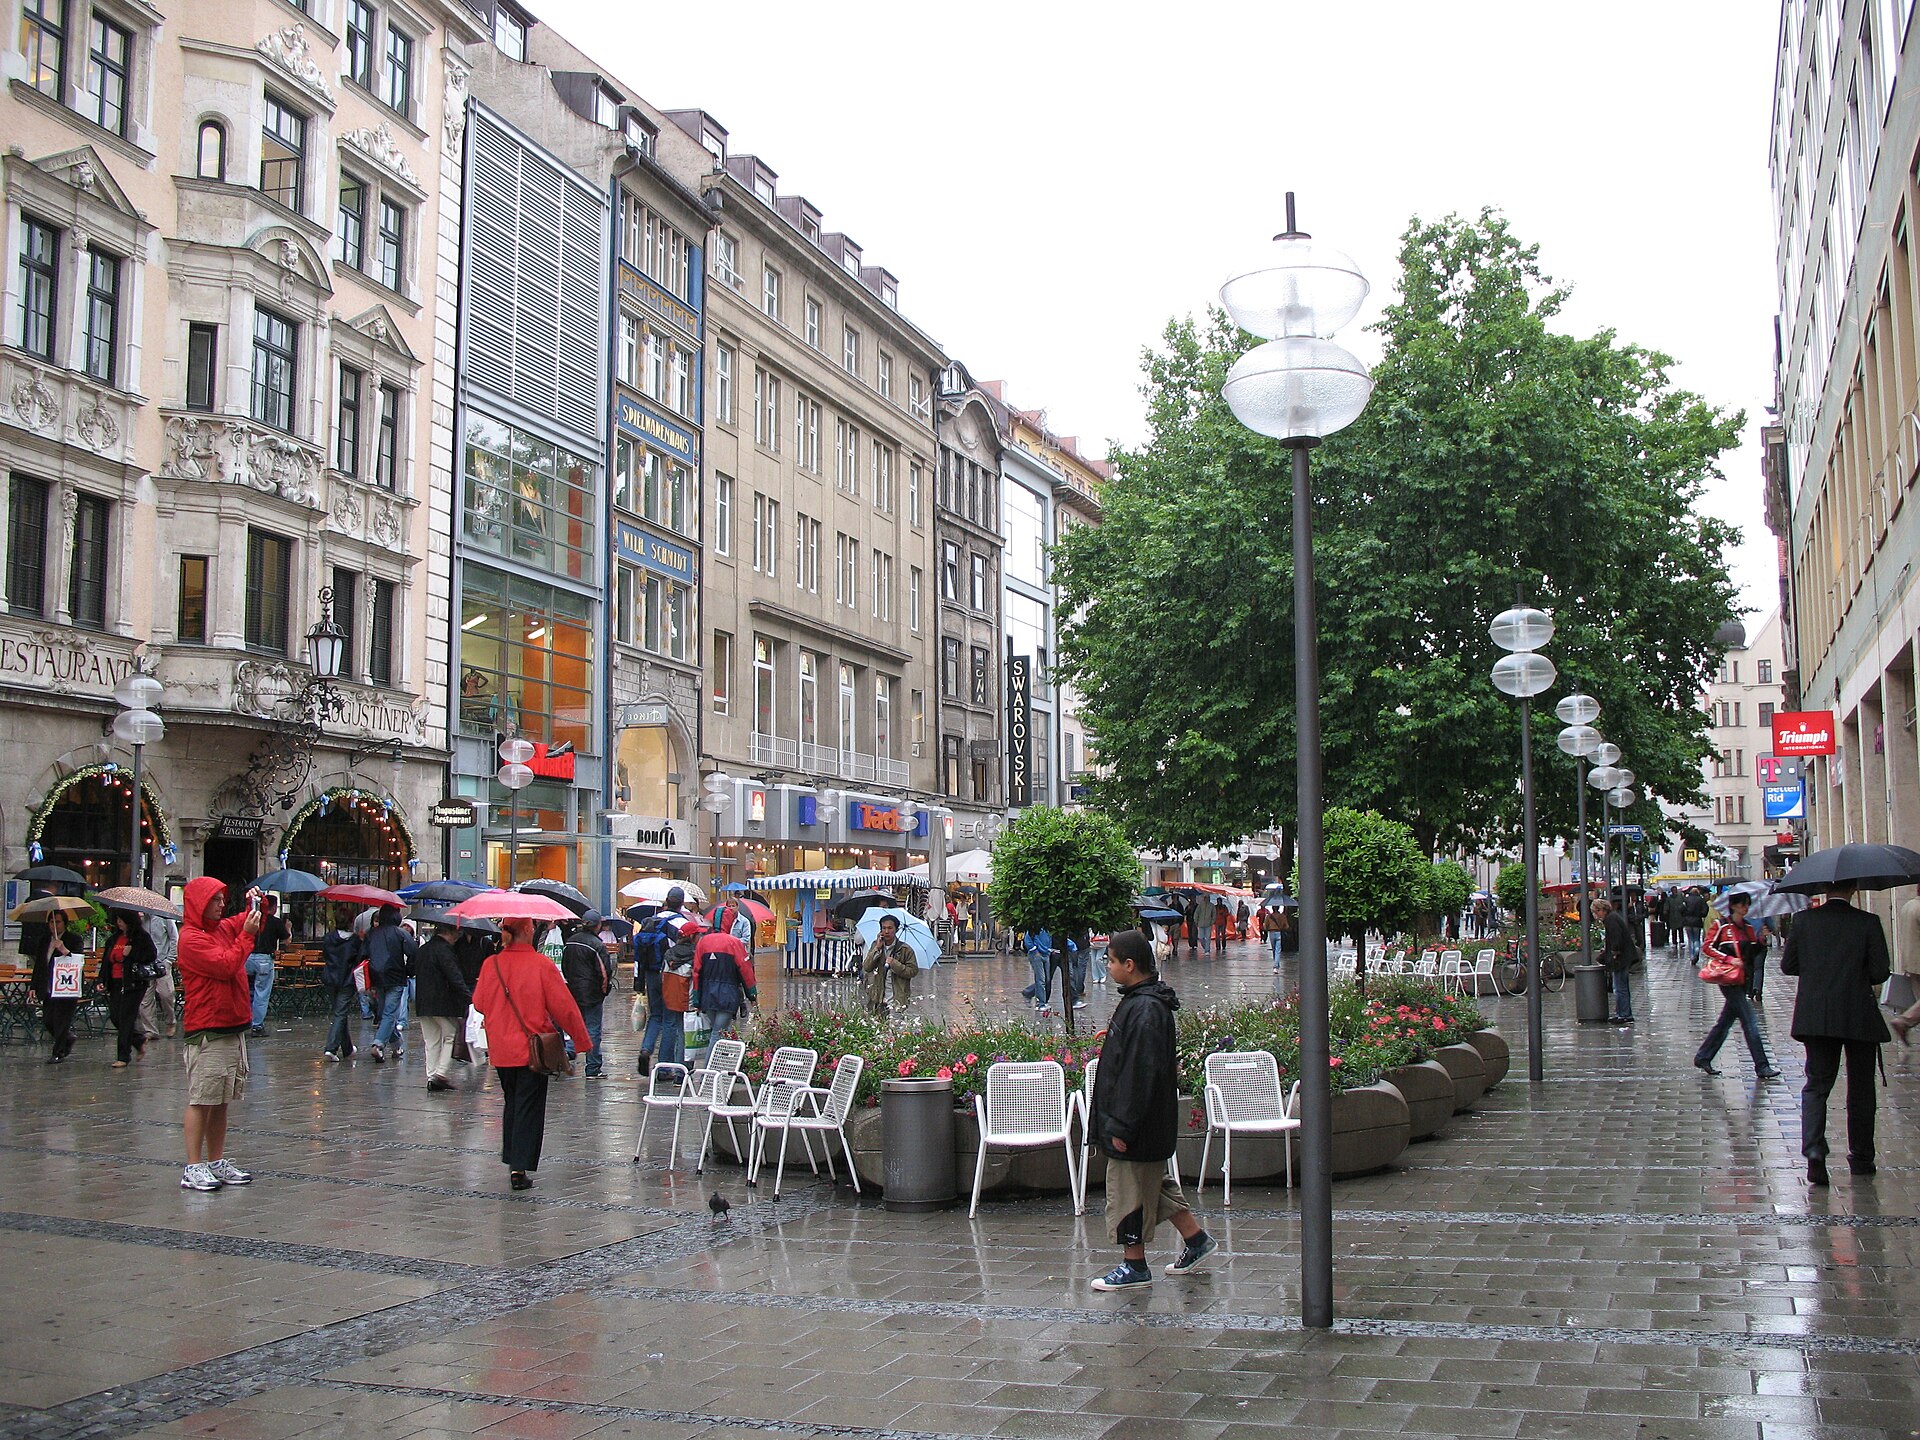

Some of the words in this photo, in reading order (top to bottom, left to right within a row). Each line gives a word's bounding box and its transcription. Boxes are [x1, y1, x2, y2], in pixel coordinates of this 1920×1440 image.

[622, 404, 690, 455] SPIELWARENHAUS
[651, 542, 688, 572] SCHMIDT
[326, 701, 410, 735] UGUSTINER
[627, 708, 663, 722] BONITA
[1011, 660, 1027, 802] SWAROVSKI
[1778, 729, 1829, 745] Triumph
[1760, 758, 1782, 783] T
[1767, 793, 1784, 802] Rid
[434, 806, 472, 816] Augustiner
[223, 817, 261, 829] RESTAURANT
[434, 815, 472, 824] Restaurant
[224, 827, 255, 836] EINGANG
[637, 822, 676, 849] BONITA
[1609, 825, 1640, 834] apellenstr.
[61, 975, 73, 985] M
